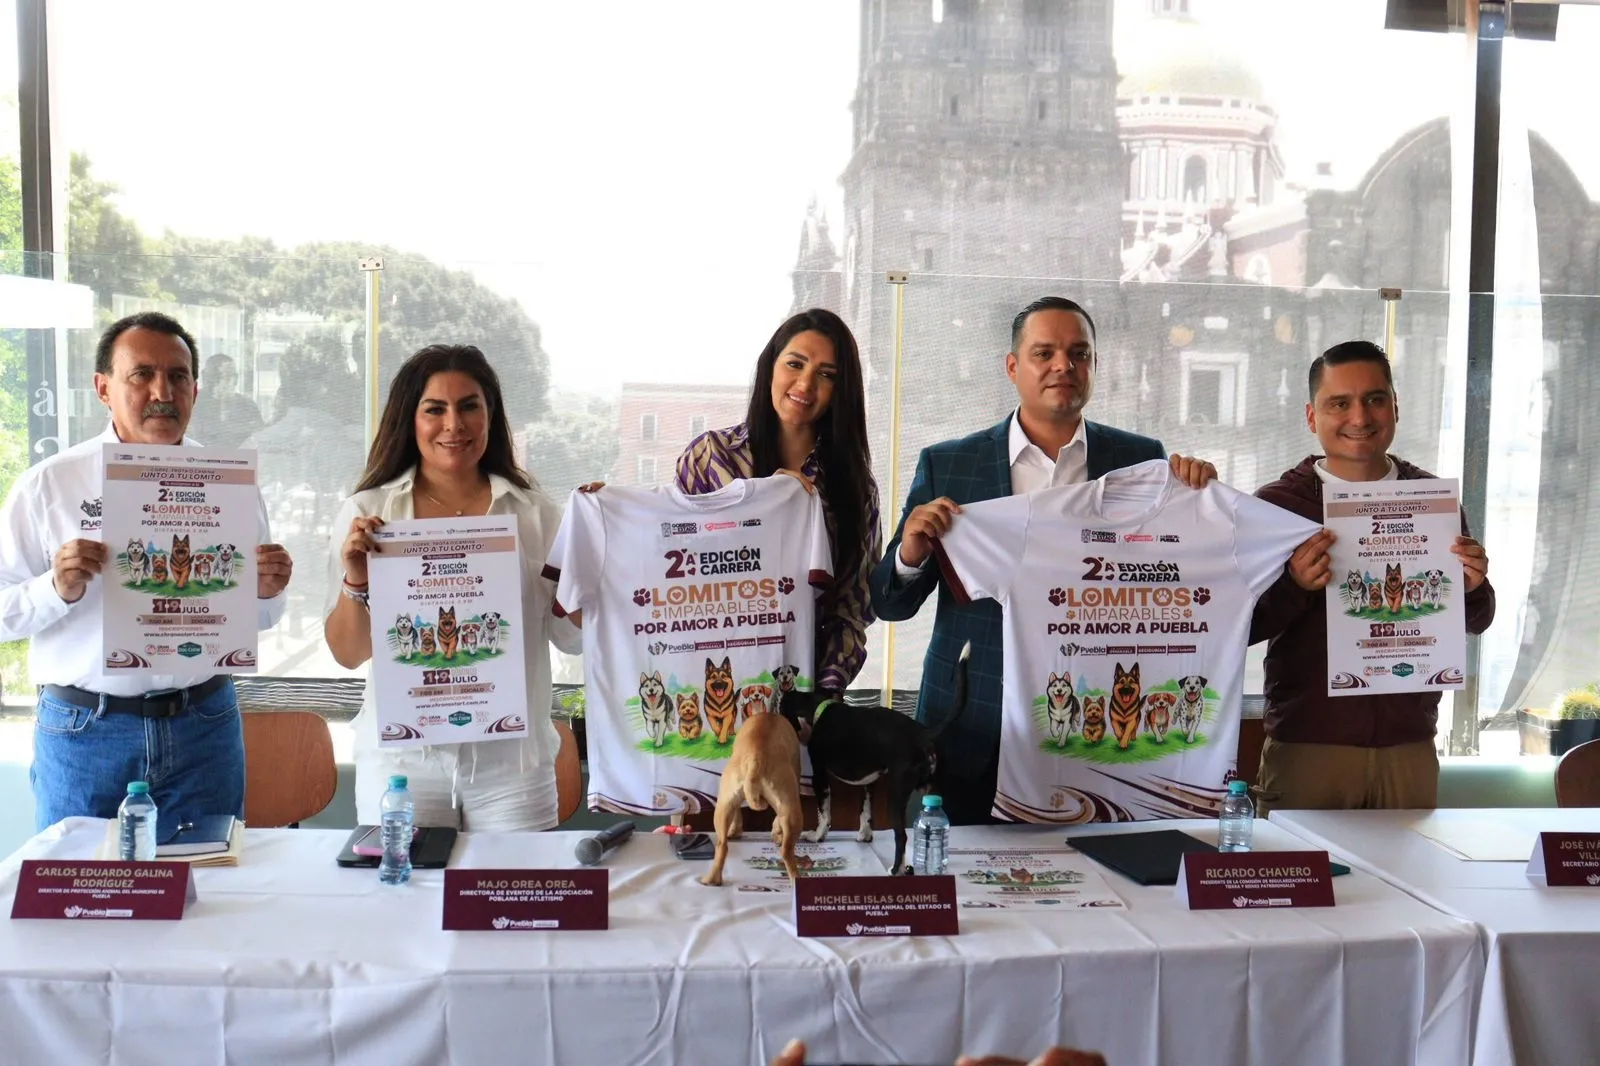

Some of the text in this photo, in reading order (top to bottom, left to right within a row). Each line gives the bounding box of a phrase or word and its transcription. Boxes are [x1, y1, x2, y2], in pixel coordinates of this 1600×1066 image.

[176, 490, 206, 498] EDICIÓN
[151, 504, 211, 515] LOMITOS
[1367, 535, 1420, 546] LOMITOS
[700, 546, 761, 564] EDICIÓN
[438, 562, 468, 570] EDICIÓN
[700, 561, 761, 576] CARRERA
[1118, 561, 1179, 572] EDICIÓN
[416, 576, 474, 588] LOMITOS
[1119, 572, 1180, 582] CARRERA
[652, 578, 776, 607] LOMITOS
[1067, 587, 1191, 607] LOMITOS
[155, 600, 179, 613] 19
[664, 600, 767, 619] IMPARABLES
[1078, 608, 1181, 621] IMPARABLES
[634, 611, 796, 635] POR AMOR A PUEBLA
[1048, 622, 1209, 635] POR AMOR A PUEBLA
[1371, 624, 1394, 636] 19
[425, 671, 449, 684] 19
[451, 675, 478, 683] JULIO
[1560, 840, 1584, 849] JOSÉ
[35, 867, 173, 878] CARLOS EDUARDO GALINA
[1206, 867, 1311, 878] RICARDO CHAVERO
[73, 878, 134, 888] RODRÍGUEZ
[477, 880, 576, 889] MAJO OREA OREA
[814, 894, 938, 904] MICHELE ISLAS GANIME
